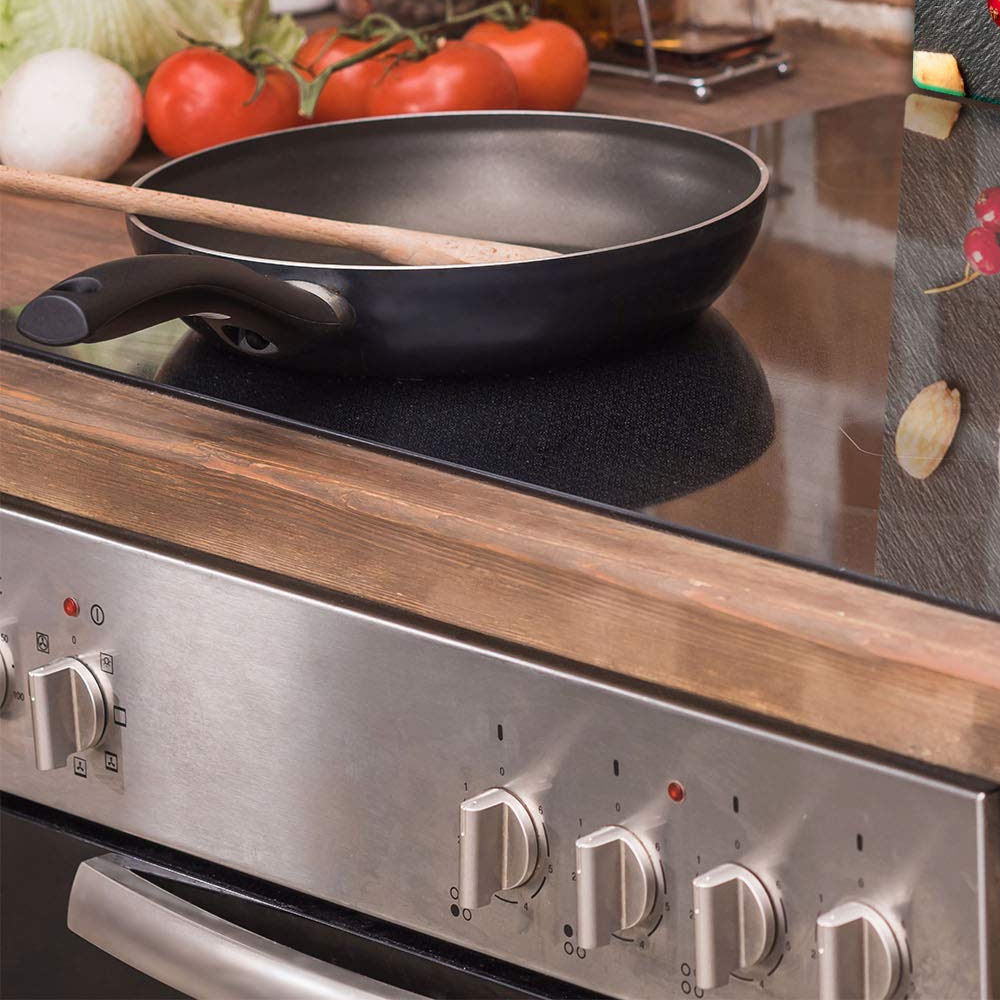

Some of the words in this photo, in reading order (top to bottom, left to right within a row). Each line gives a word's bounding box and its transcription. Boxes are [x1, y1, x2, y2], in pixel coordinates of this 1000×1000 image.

[72, 635, 77, 645] 0
[500, 767, 505, 776] 0
[464, 782, 468, 791] 1
[538, 805, 544, 815] 6
[615, 802, 621, 812] 0
[578, 818, 582, 827] 1
[655, 842, 661, 852] 6
[735, 840, 740, 850] 0
[697, 855, 701, 864] 1
[548, 864, 553, 874] 5
[571, 872, 577, 881] 2
[523, 902, 529, 911] 4
[665, 902, 670, 912] 5
[639, 940, 645, 949] 4
